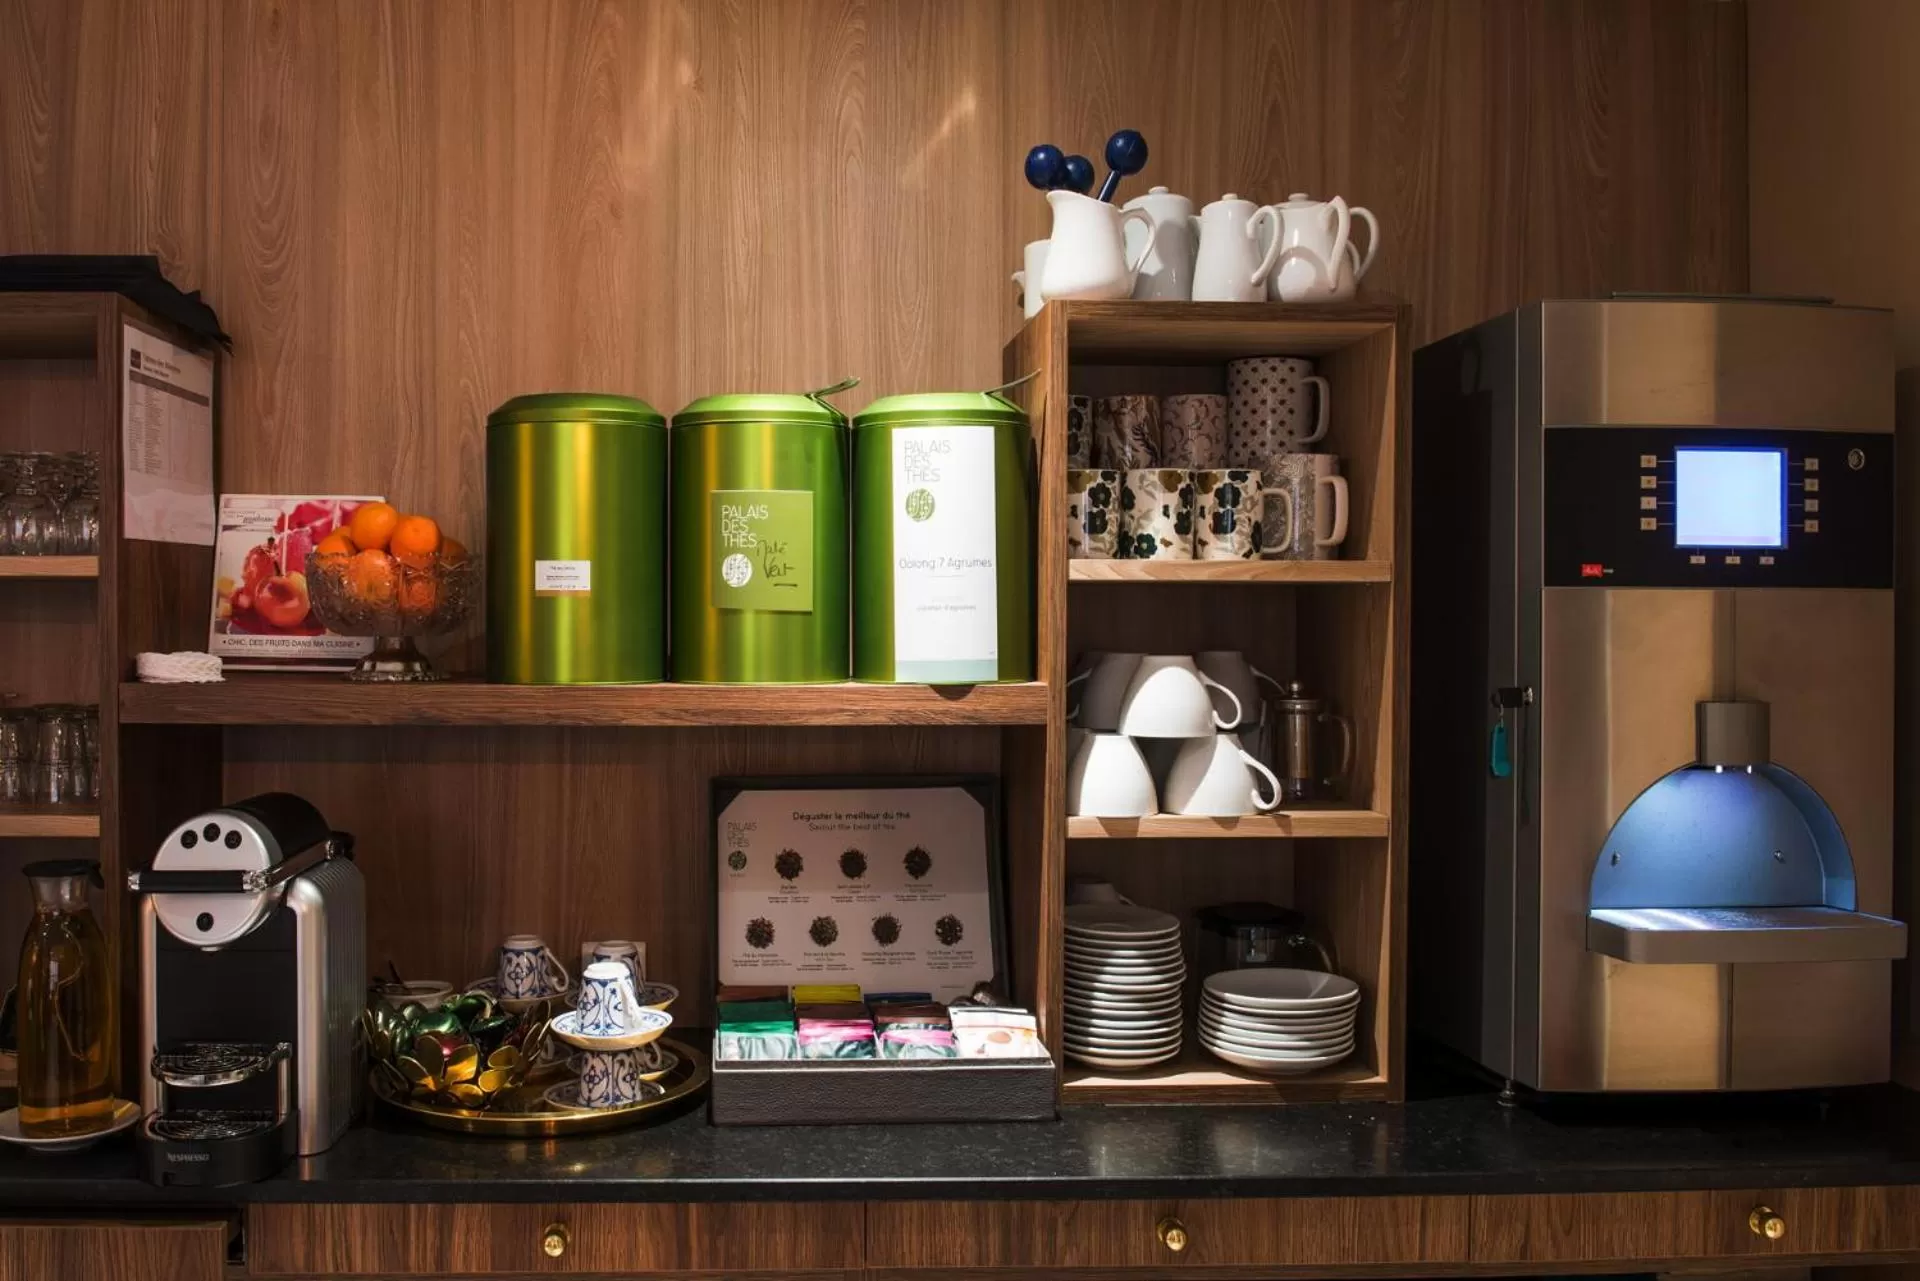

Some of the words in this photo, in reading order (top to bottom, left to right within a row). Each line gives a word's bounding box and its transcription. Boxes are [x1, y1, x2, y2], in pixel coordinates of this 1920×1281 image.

[904, 440, 953, 454] PALAIS
[904, 454, 931, 470] DES
[721, 504, 769, 520] PALAIS
[721, 518, 749, 534] DES
[899, 557, 936, 570] Oolong
[939, 557, 945, 569] 7
[947, 557, 993, 570] Agrumes
[265, 639, 290, 648] FRUITS
[292, 639, 312, 648] DANS
[313, 640, 324, 648] MA
[325, 640, 355, 649] CUISINE
[845, 811, 880, 820] meilleur
[882, 811, 894, 820] du
